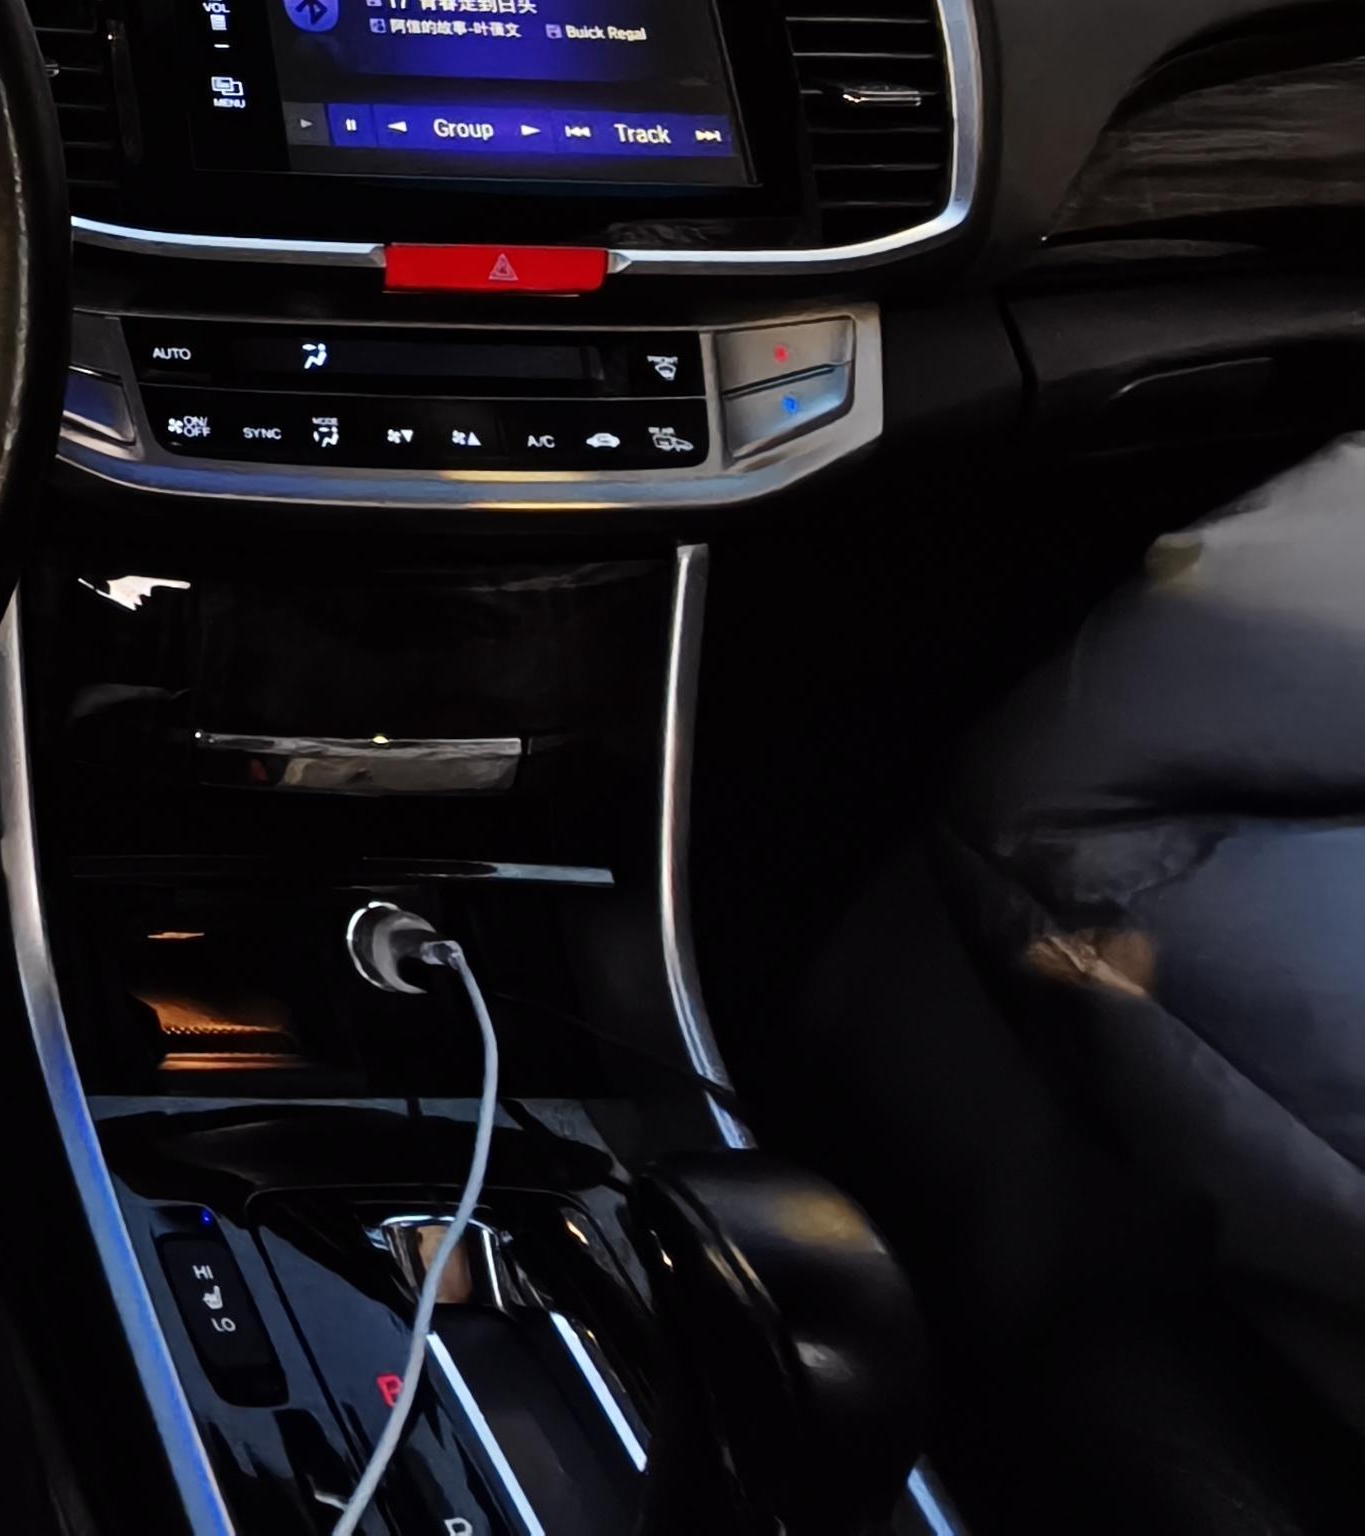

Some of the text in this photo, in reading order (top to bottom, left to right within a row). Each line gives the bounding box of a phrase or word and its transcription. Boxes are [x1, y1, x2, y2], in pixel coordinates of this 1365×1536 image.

[202, 2, 230, 13] VOL
[565, 25, 647, 42] Buick Regal
[433, 118, 494, 142] Group
[614, 123, 671, 145] Track
[152, 347, 191, 360] AUTO
[183, 426, 211, 438] OFF
[243, 426, 282, 440] SYNC
[527, 434, 555, 449] A/C
[193, 1265, 213, 1280] HI
[211, 1317, 236, 1334] LO
